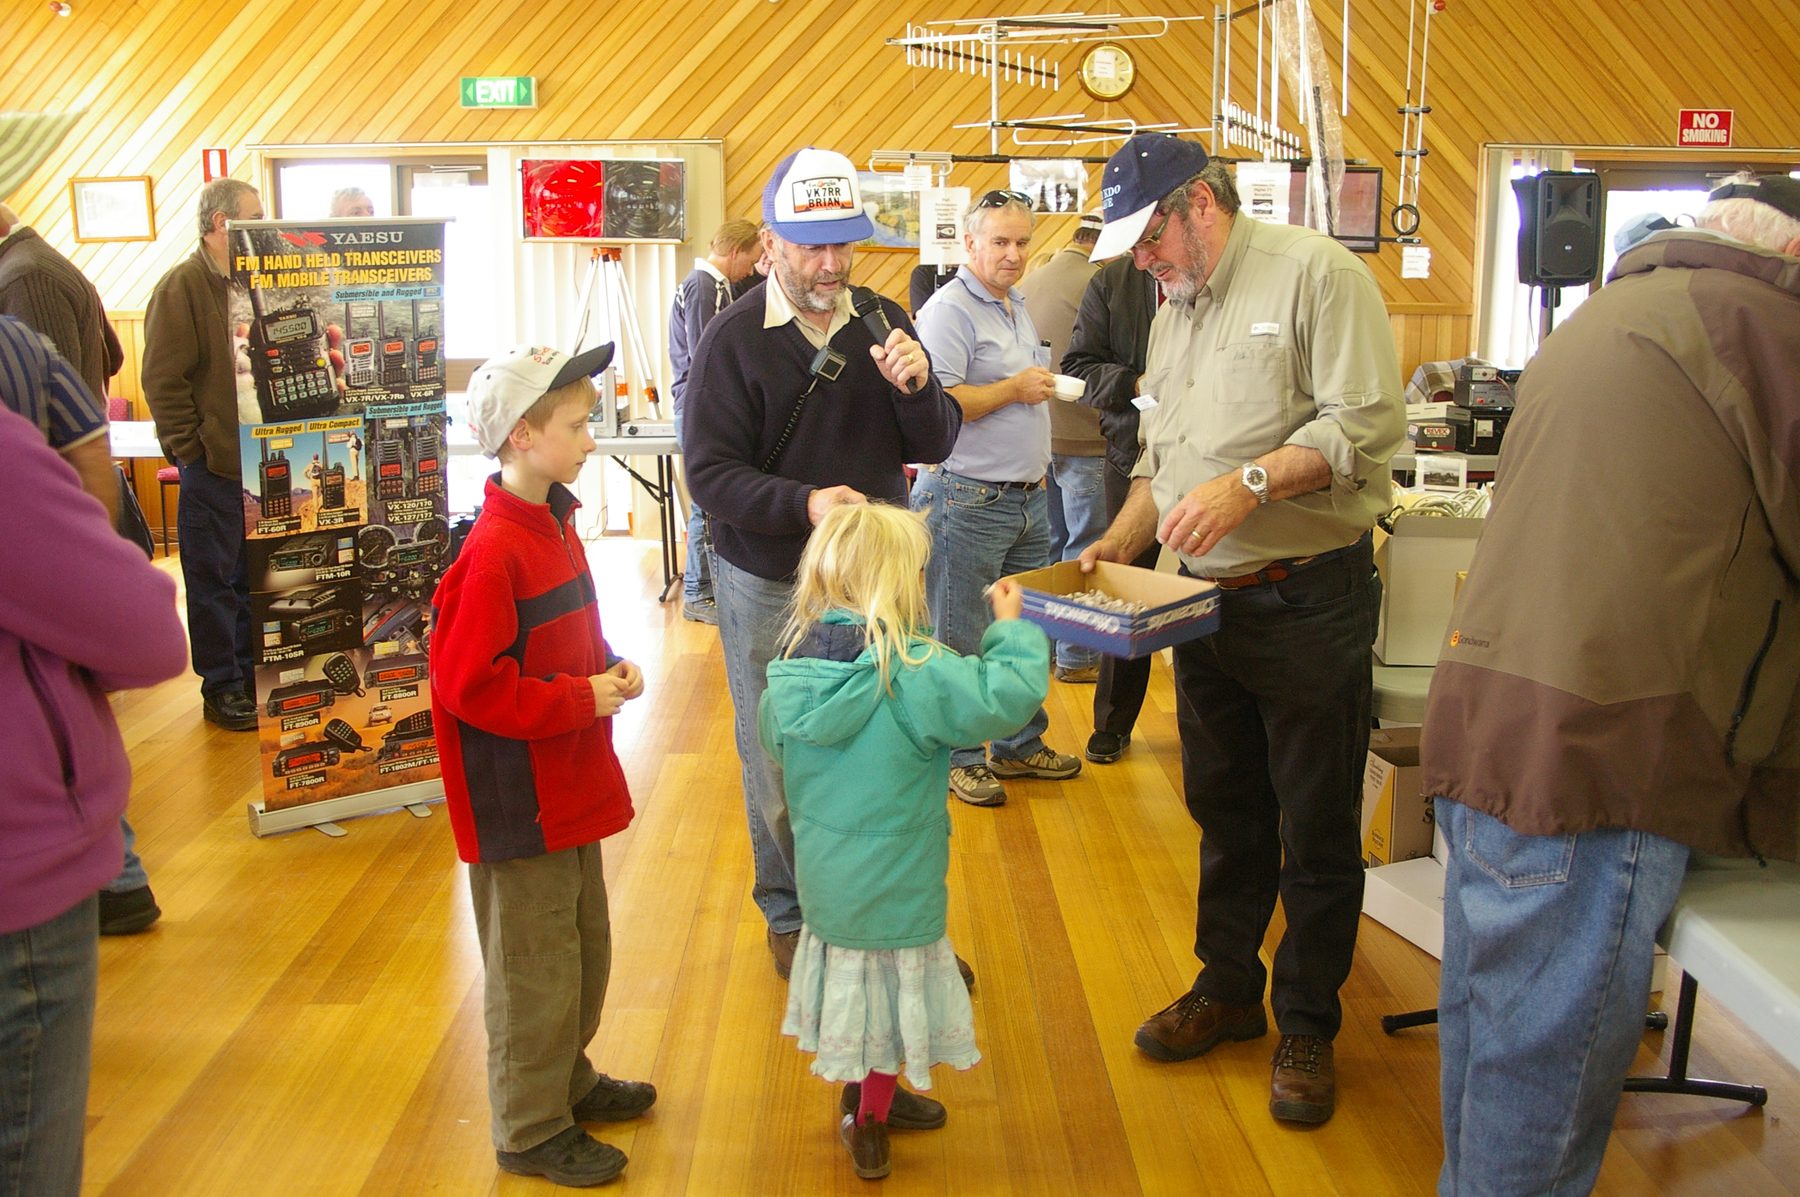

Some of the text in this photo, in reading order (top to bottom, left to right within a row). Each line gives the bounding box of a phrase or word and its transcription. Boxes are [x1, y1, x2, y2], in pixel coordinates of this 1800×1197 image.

[476, 79, 516, 103] EXIT
[1692, 112, 1720, 129] NO
[1682, 128, 1728, 143] SMOKING
[806, 187, 841, 198] VK7RR
[808, 197, 840, 208] BRIAN
[330, 231, 404, 245] YAESU
[236, 249, 442, 272] FM HAND HELD TRANSCEIVERS
[250, 267, 432, 289] FM MOBILE TRANSCEIVERS
[335, 289, 379, 299] Submersible
[396, 287, 422, 297] Rugged
[368, 401, 443, 415] Submersible and Rugged
[255, 424, 302, 436] Ultra Rugged
[309, 418, 360, 431] Ultra Compact
[315, 570, 351, 581] FTM-10R
